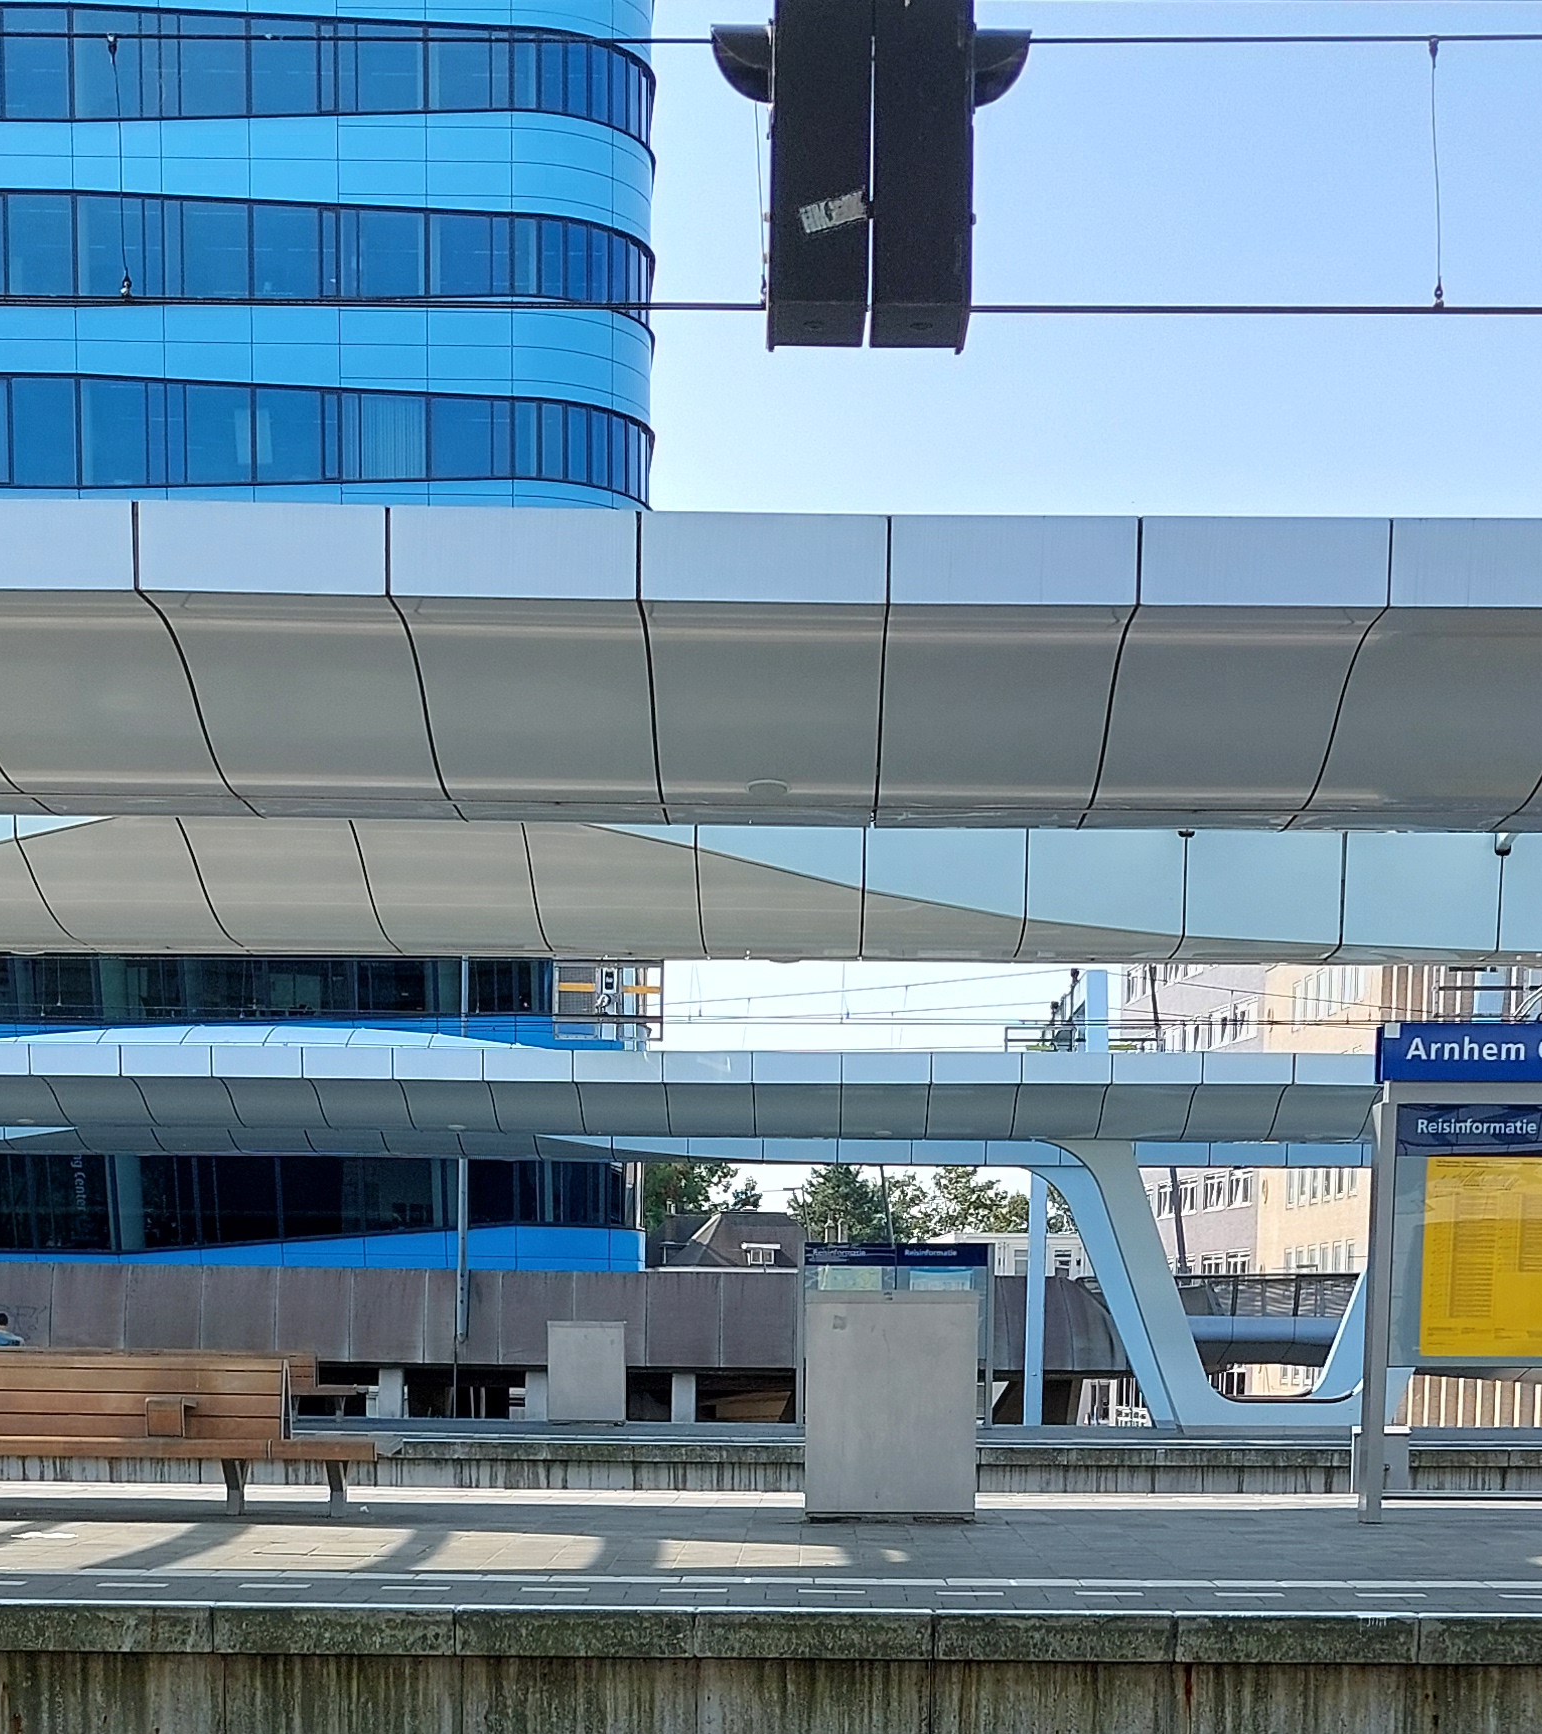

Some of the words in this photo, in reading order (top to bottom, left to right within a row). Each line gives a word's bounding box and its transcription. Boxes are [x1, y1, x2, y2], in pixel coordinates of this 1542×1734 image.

[1405, 1036, 1525, 1060] Arnhem
[1417, 1119, 1537, 1134] Reisinformatie
[74, 1172, 86, 1210] Center
[904, 1249, 958, 1257] Reisinformatie
